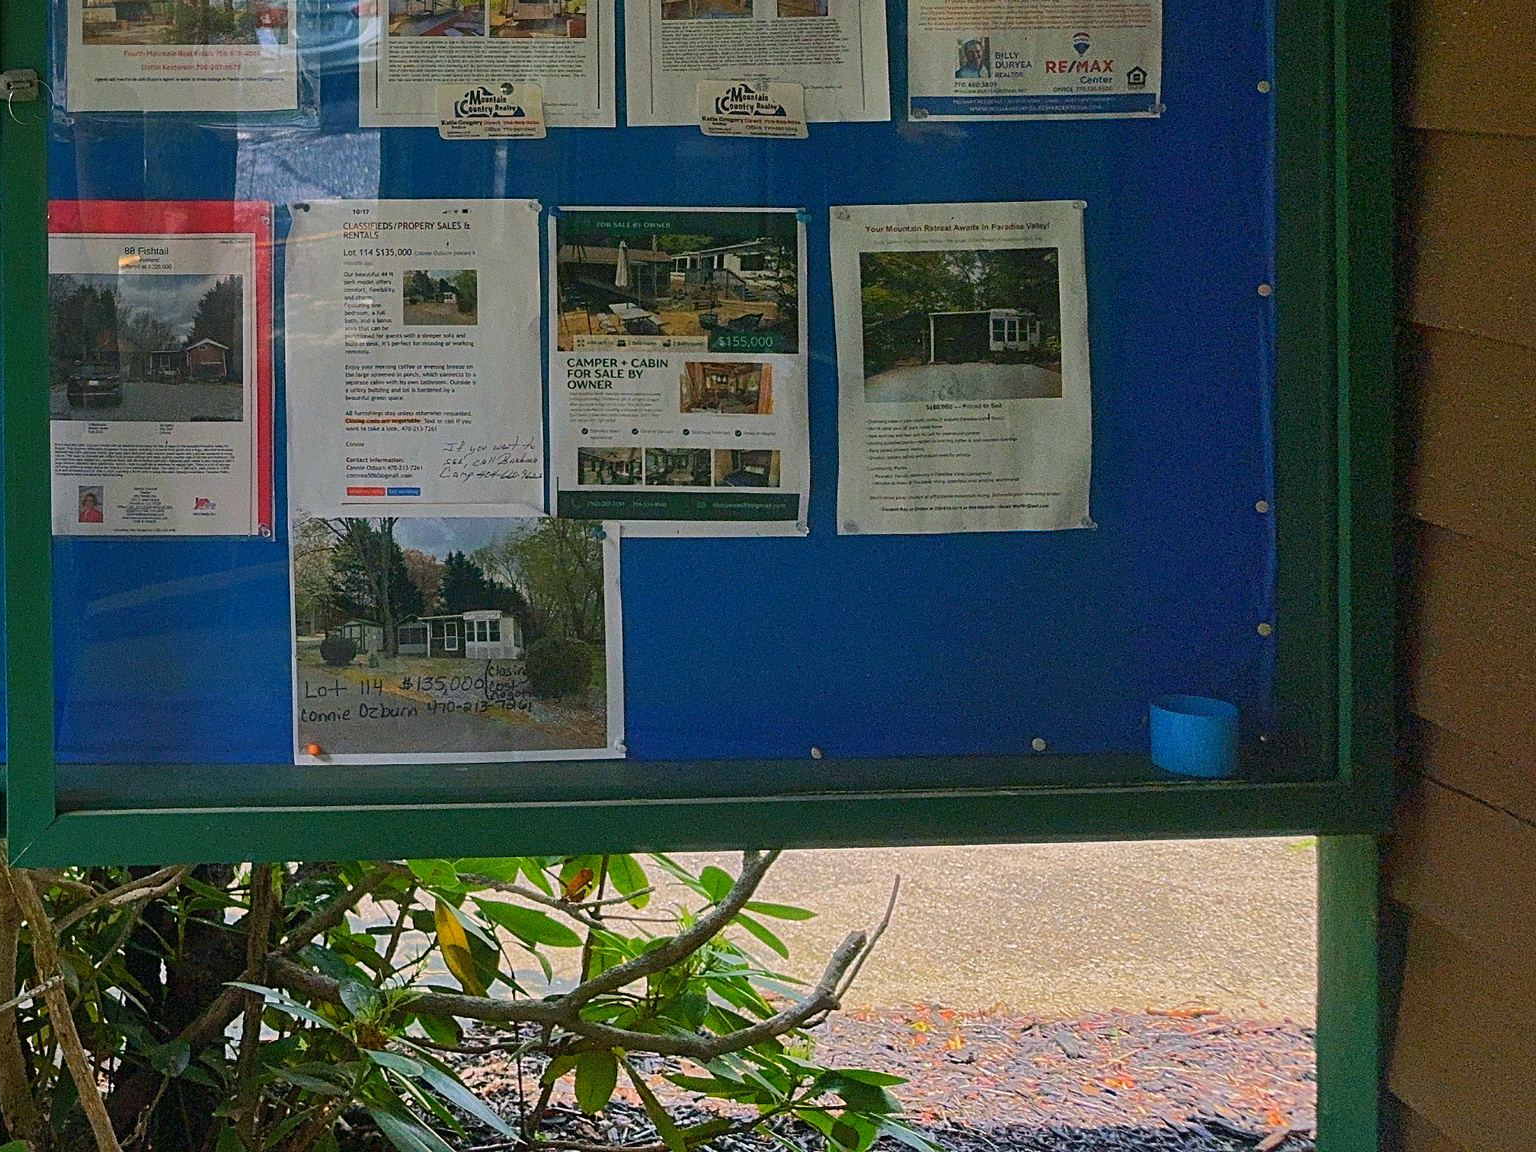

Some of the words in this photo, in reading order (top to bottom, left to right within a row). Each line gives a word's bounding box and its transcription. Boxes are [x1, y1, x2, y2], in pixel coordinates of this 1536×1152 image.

[995, 51, 1020, 60] BILLY
[995, 61, 1032, 69] DURYEA
[1045, 59, 1114, 74] RE/MAX
[1080, 76, 1113, 84] Center
[470, 90, 506, 105] Mountain
[731, 87, 768, 102] Mountain
[460, 100, 493, 115] Country
[720, 96, 754, 112] Country
[1026, 222, 1050, 230] Valley!
[138, 247, 168, 255] Fishtail
[376, 248, 412, 256] $135,000
[718, 335, 773, 348] $155,000
[567, 358, 618, 368] CAMPER
[631, 358, 669, 368] CABIN
[567, 369, 592, 378] FOR
[595, 369, 624, 378] SALE
[628, 369, 644, 378] BY
[567, 380, 613, 390] OWNER
[305, 680, 348, 698] Lot
[361, 678, 382, 696] 114
[399, 675, 484, 696] $135,000
[359, 703, 418, 718] Ozburn
